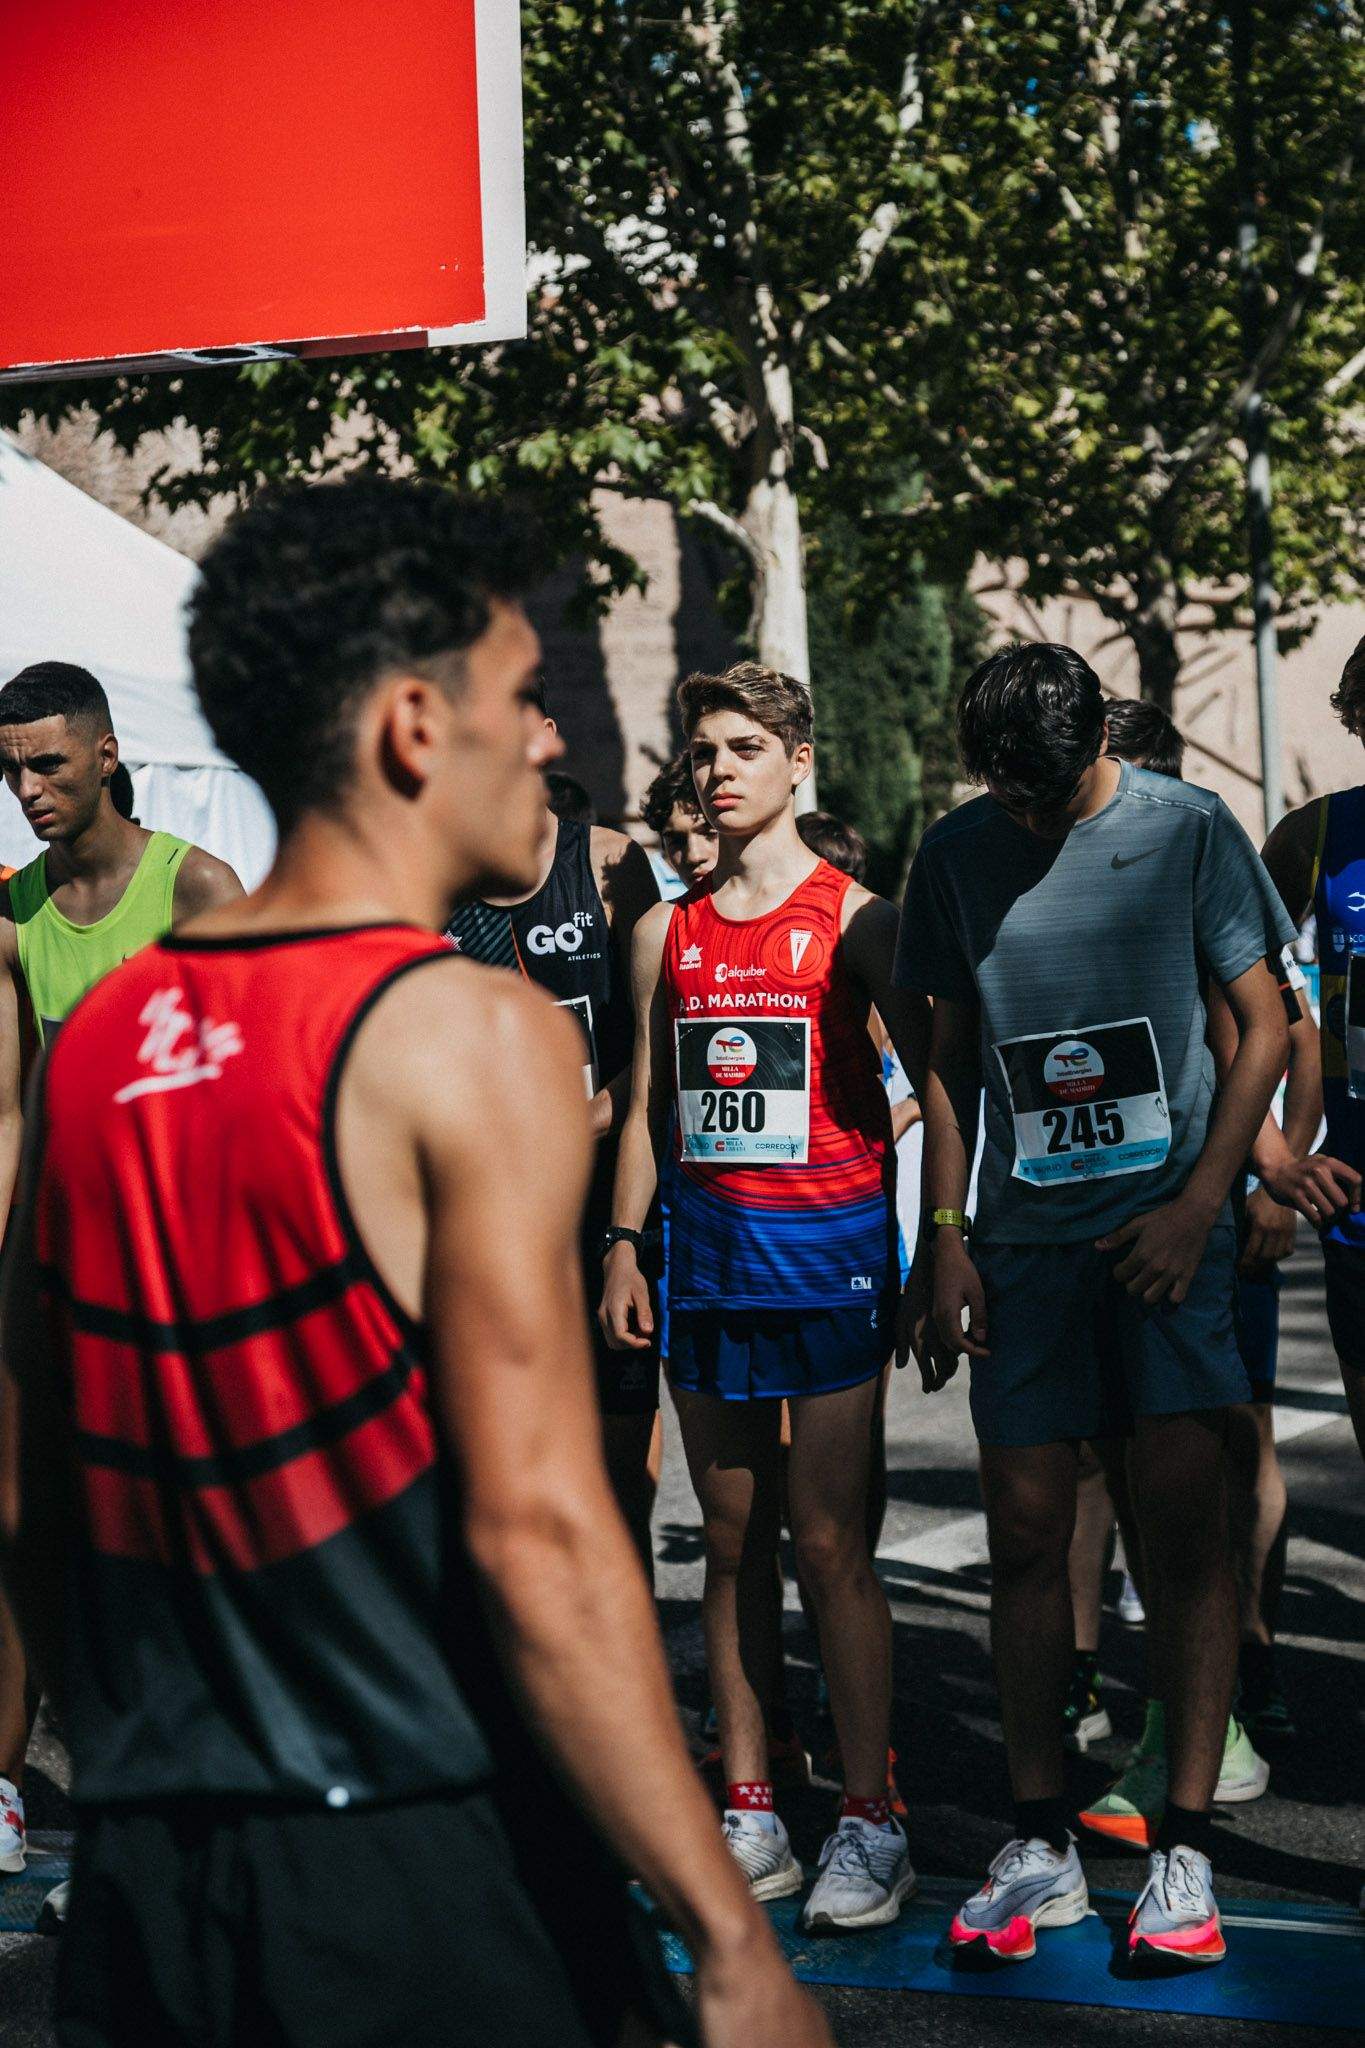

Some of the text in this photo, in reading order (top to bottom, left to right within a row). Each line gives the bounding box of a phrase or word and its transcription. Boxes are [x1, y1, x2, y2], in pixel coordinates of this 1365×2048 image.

[527, 912, 593, 955] GO fit
[568, 953, 601, 961] ATHLETICS
[727, 964, 767, 982] alquiber
[708, 992, 807, 1009] MARATHON
[701, 1091, 766, 1133] 260
[1042, 1101, 1124, 1154] 245
